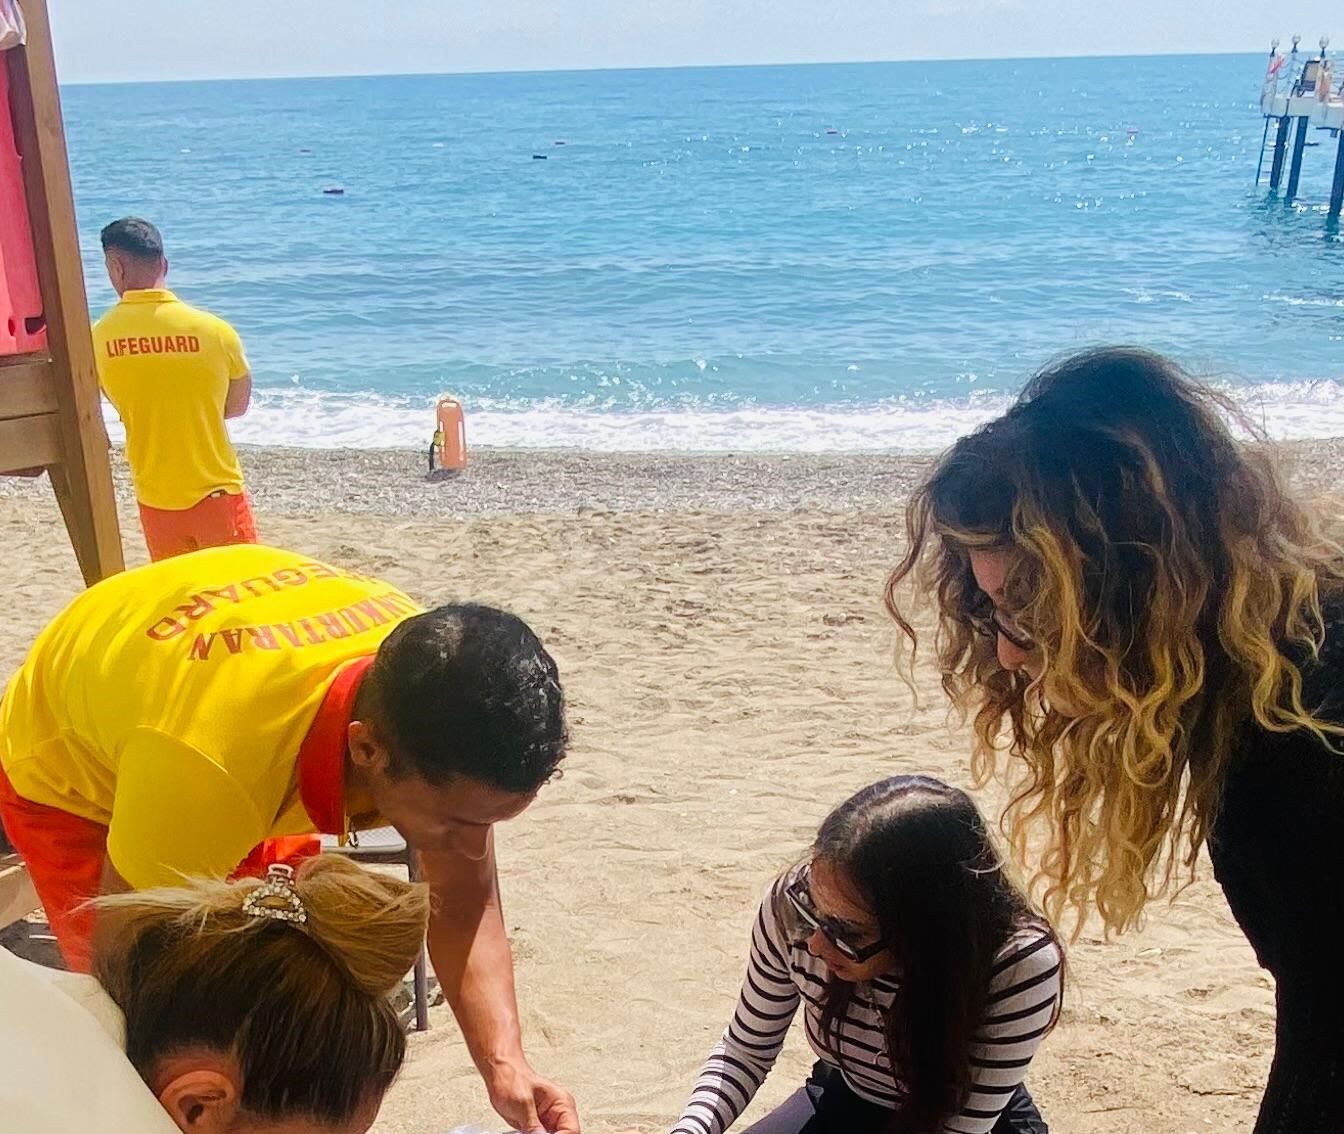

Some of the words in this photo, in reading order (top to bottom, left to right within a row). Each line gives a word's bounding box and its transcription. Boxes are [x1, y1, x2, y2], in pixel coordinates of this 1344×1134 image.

[106, 335, 200, 358] LIFEGUARD
[146, 562, 376, 641] EGUARD
[187, 591, 418, 661] NKURTARAN
